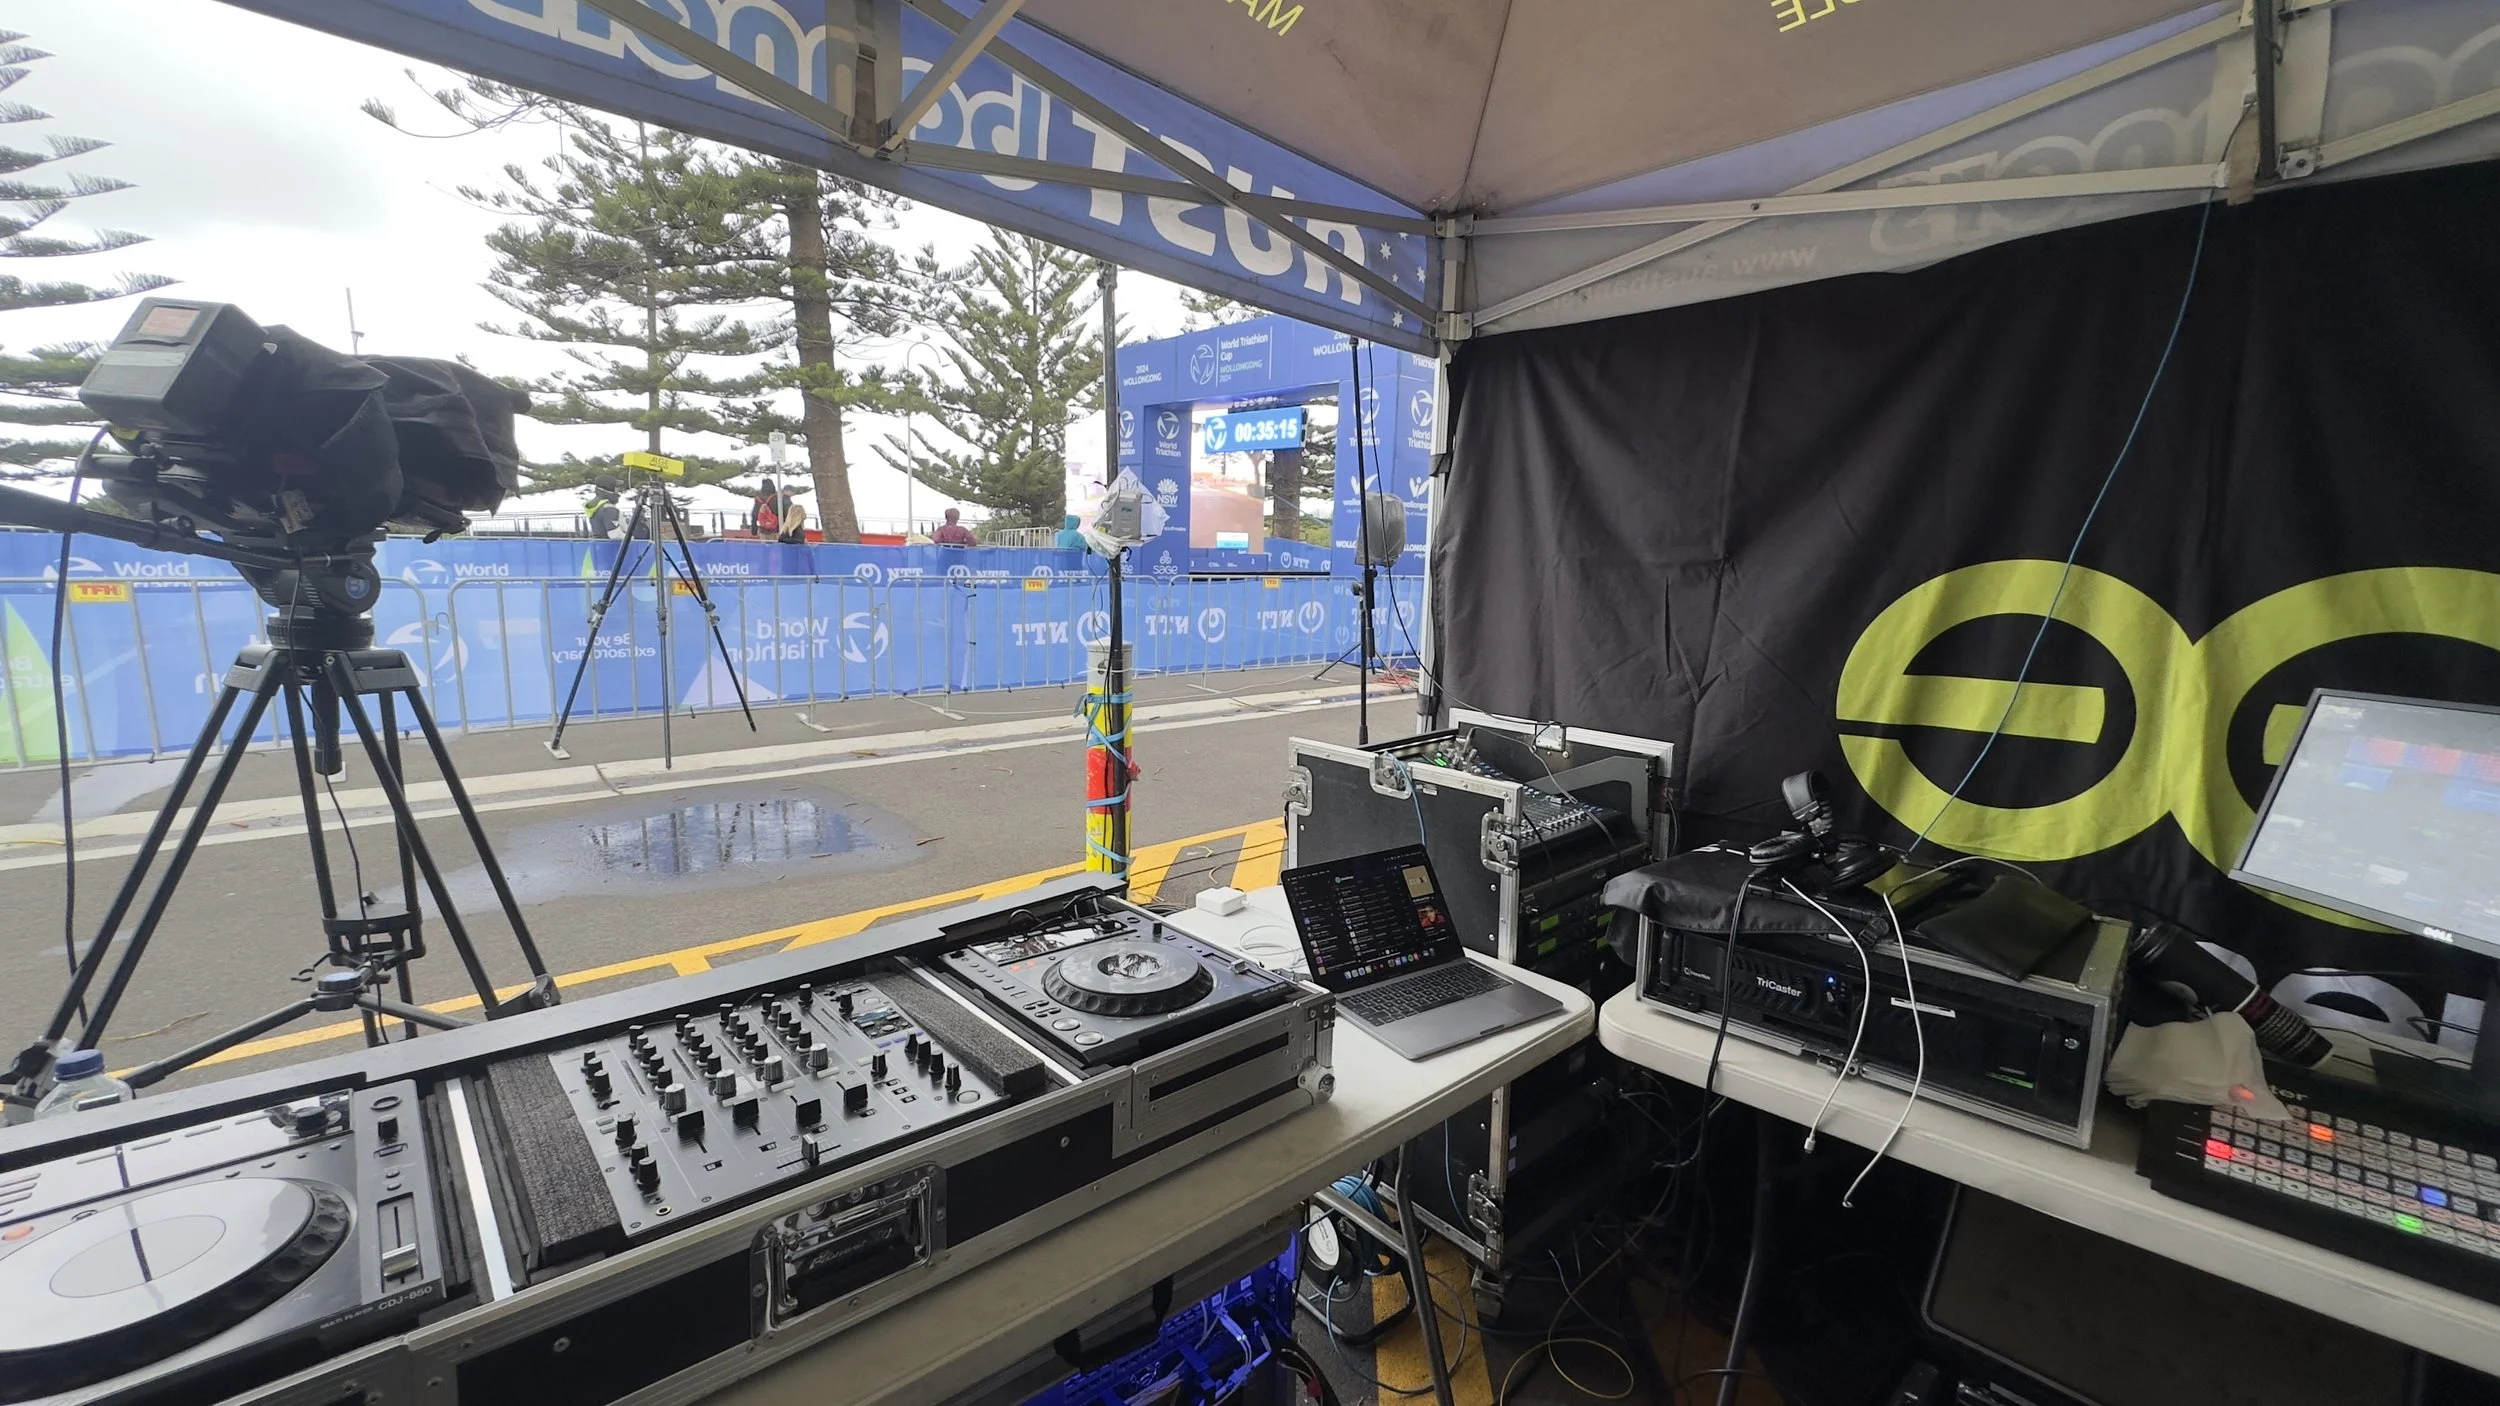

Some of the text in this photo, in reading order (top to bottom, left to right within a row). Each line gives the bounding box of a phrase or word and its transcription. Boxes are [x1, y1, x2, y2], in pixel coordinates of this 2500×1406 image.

[1221, 332, 1269, 350] World Triathlon
[1220, 351, 1233, 363] Cup
[1123, 372, 1162, 387] WOLLONGONG
[1234, 418, 1298, 443] 00:35:15
[1159, 440, 1178, 450] World
[1157, 494, 1178, 504] NSW
[114, 561, 190, 577] World
[454, 563, 509, 577] World
[707, 563, 749, 575] World
[1293, 558, 1310, 569] NTT
[887, 567, 923, 582] NTT
[1756, 976, 1803, 998] TriCaster
[345, 1306, 374, 1321] PLAYER
[379, 1285, 433, 1311] CDJ-850
